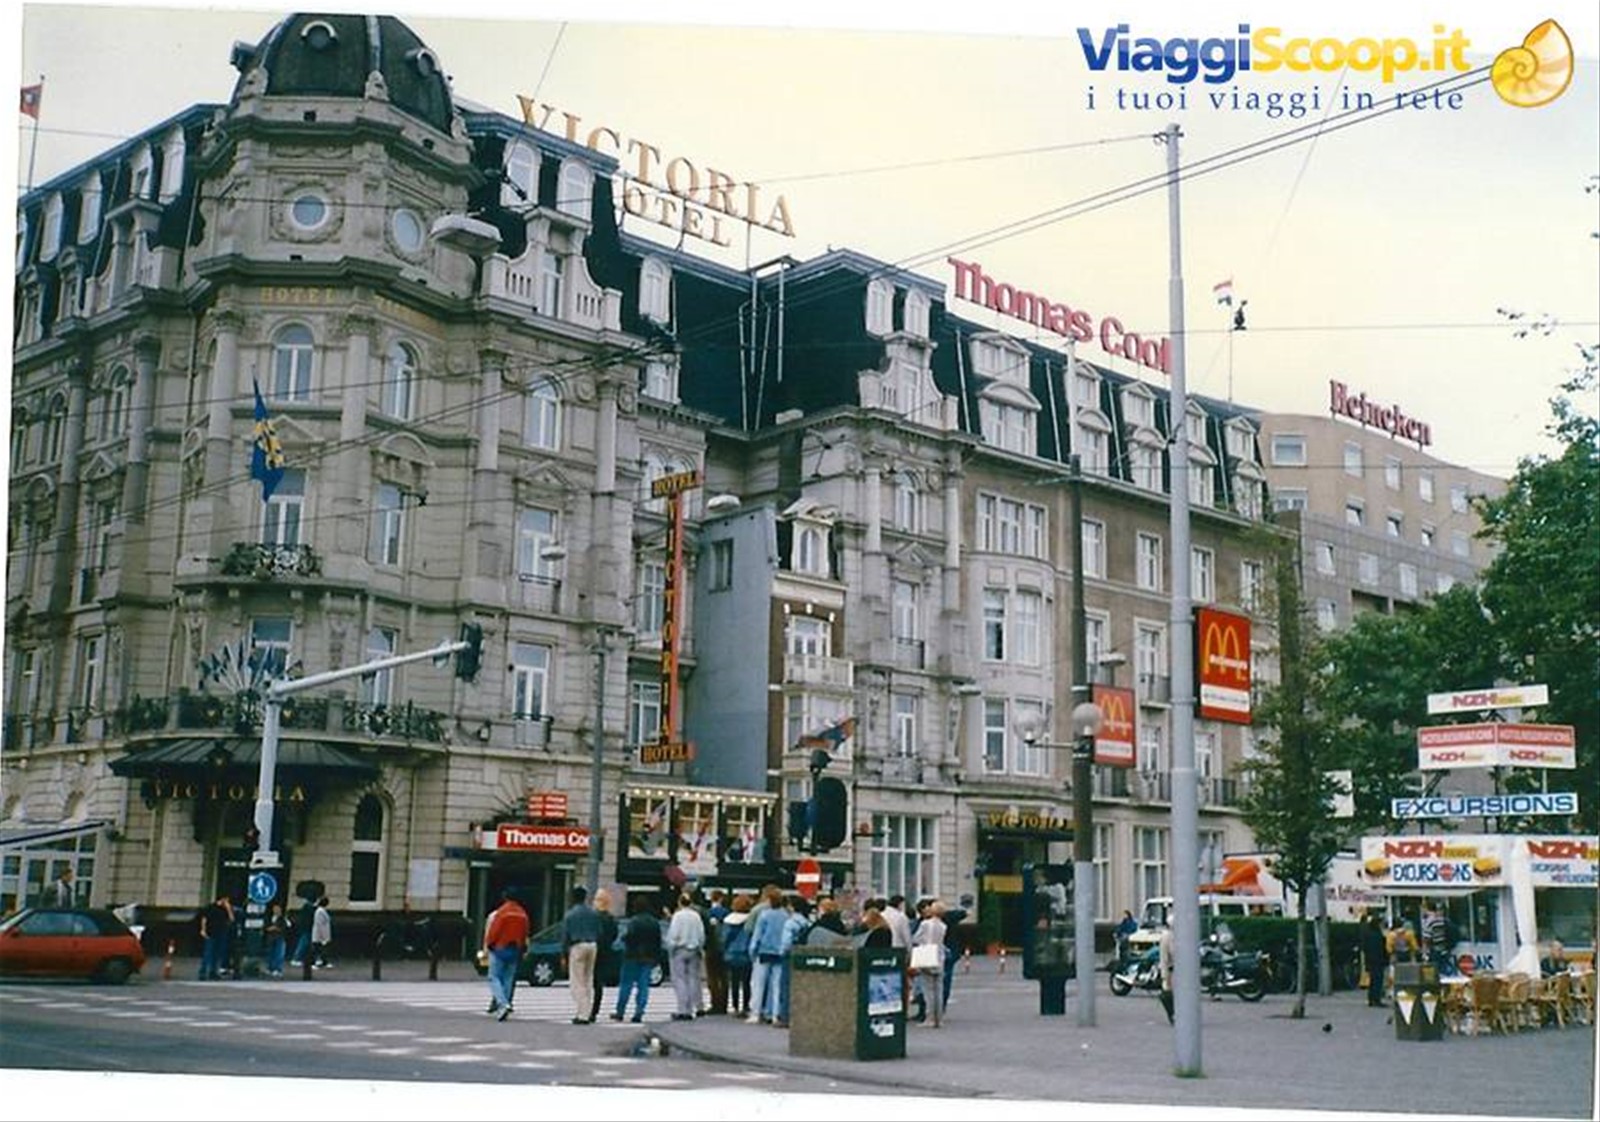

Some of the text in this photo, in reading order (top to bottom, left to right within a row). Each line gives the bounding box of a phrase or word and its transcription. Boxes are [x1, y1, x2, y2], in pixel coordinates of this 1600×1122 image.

[624, 185, 731, 247] OTEL
[260, 285, 336, 304] HOTEL
[948, 256, 1094, 344] Thomas
[1329, 379, 1432, 447] Heineken
[643, 745, 687, 764] HOTEL
[152, 783, 305, 800] VICTOIA
[1395, 795, 1573, 815] EXCURSIONS
[503, 829, 566, 846] Thomas
